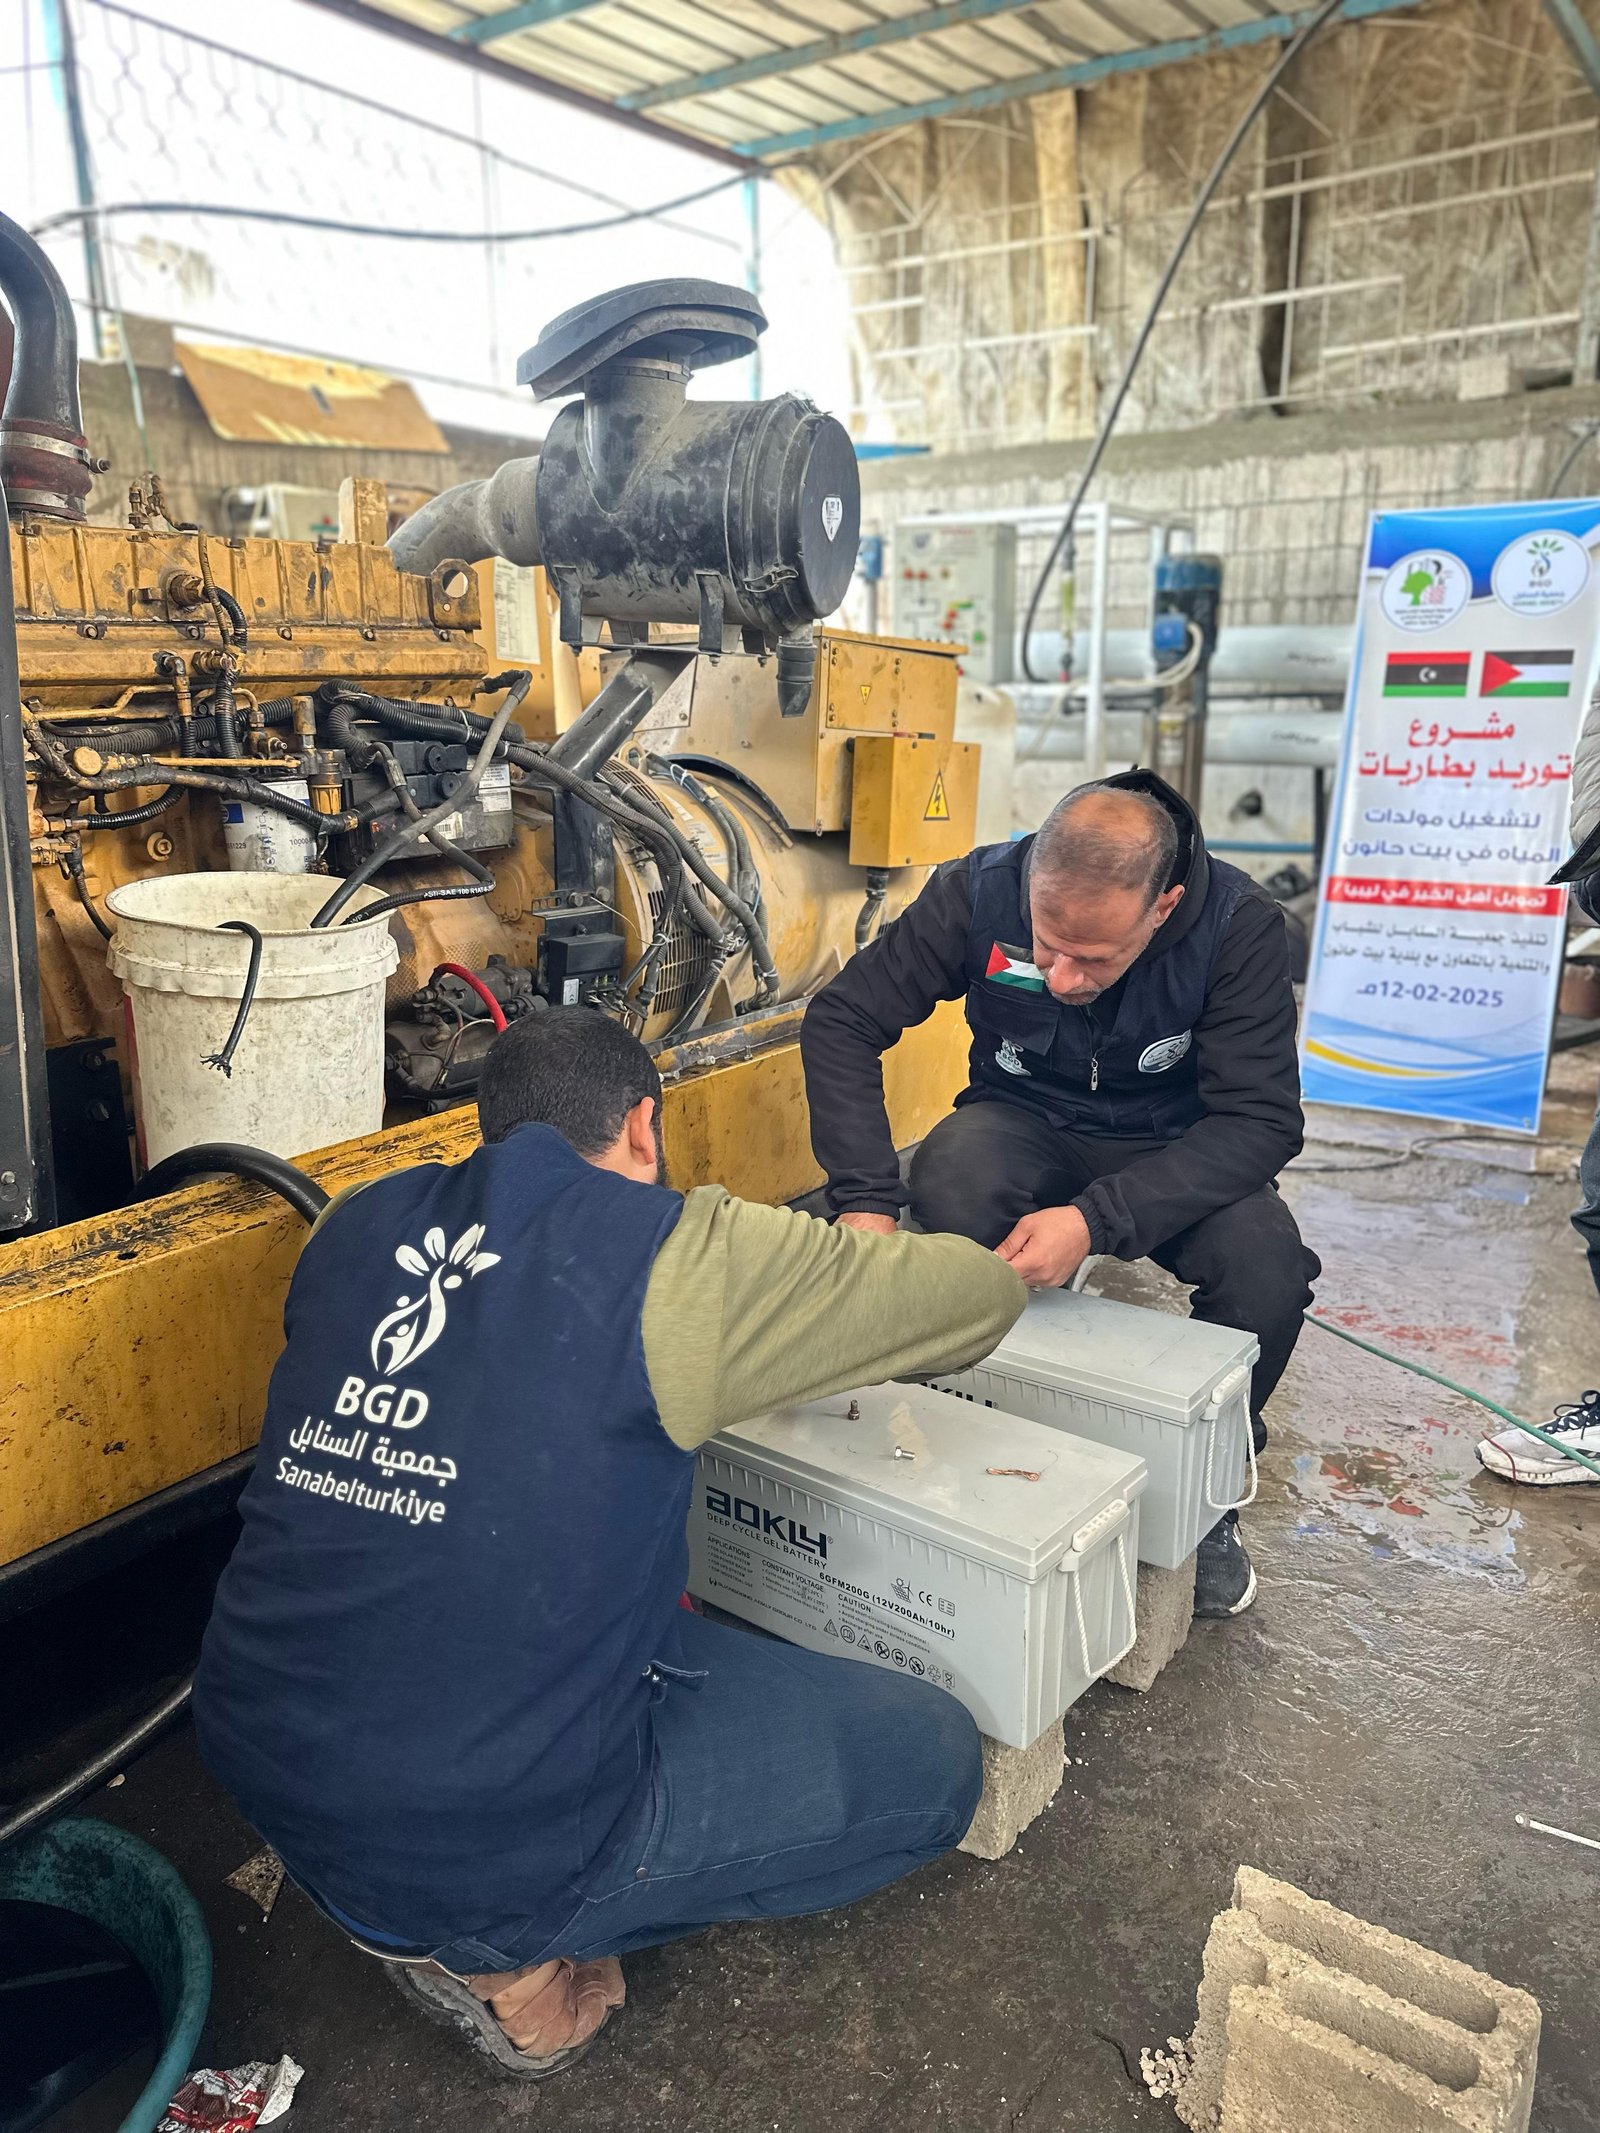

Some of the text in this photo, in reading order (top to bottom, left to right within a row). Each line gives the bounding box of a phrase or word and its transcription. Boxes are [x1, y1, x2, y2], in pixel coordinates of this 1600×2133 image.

[1359, 752, 1476, 788] بطاريات
[1365, 808, 1541, 829] لتشغيل مولدات
[1343, 839, 1560, 867] المياه في بيت حانون
[1493, 892, 1548, 908] تمويل
[334, 1375, 429, 1429] BGD
[289, 1415, 458, 1488] جمعية السنابل
[275, 1456, 446, 1526] Sanabelturkiye
[707, 1512, 828, 1570] DEEP CYCLE GEL BATTERY
[762, 1559, 795, 1579] CONSTANT
[819, 1572, 870, 1600] 6GFM200G
[872, 1594, 956, 1639] (12V200Ah/10hr)
[918, 1591, 933, 1607] CE
